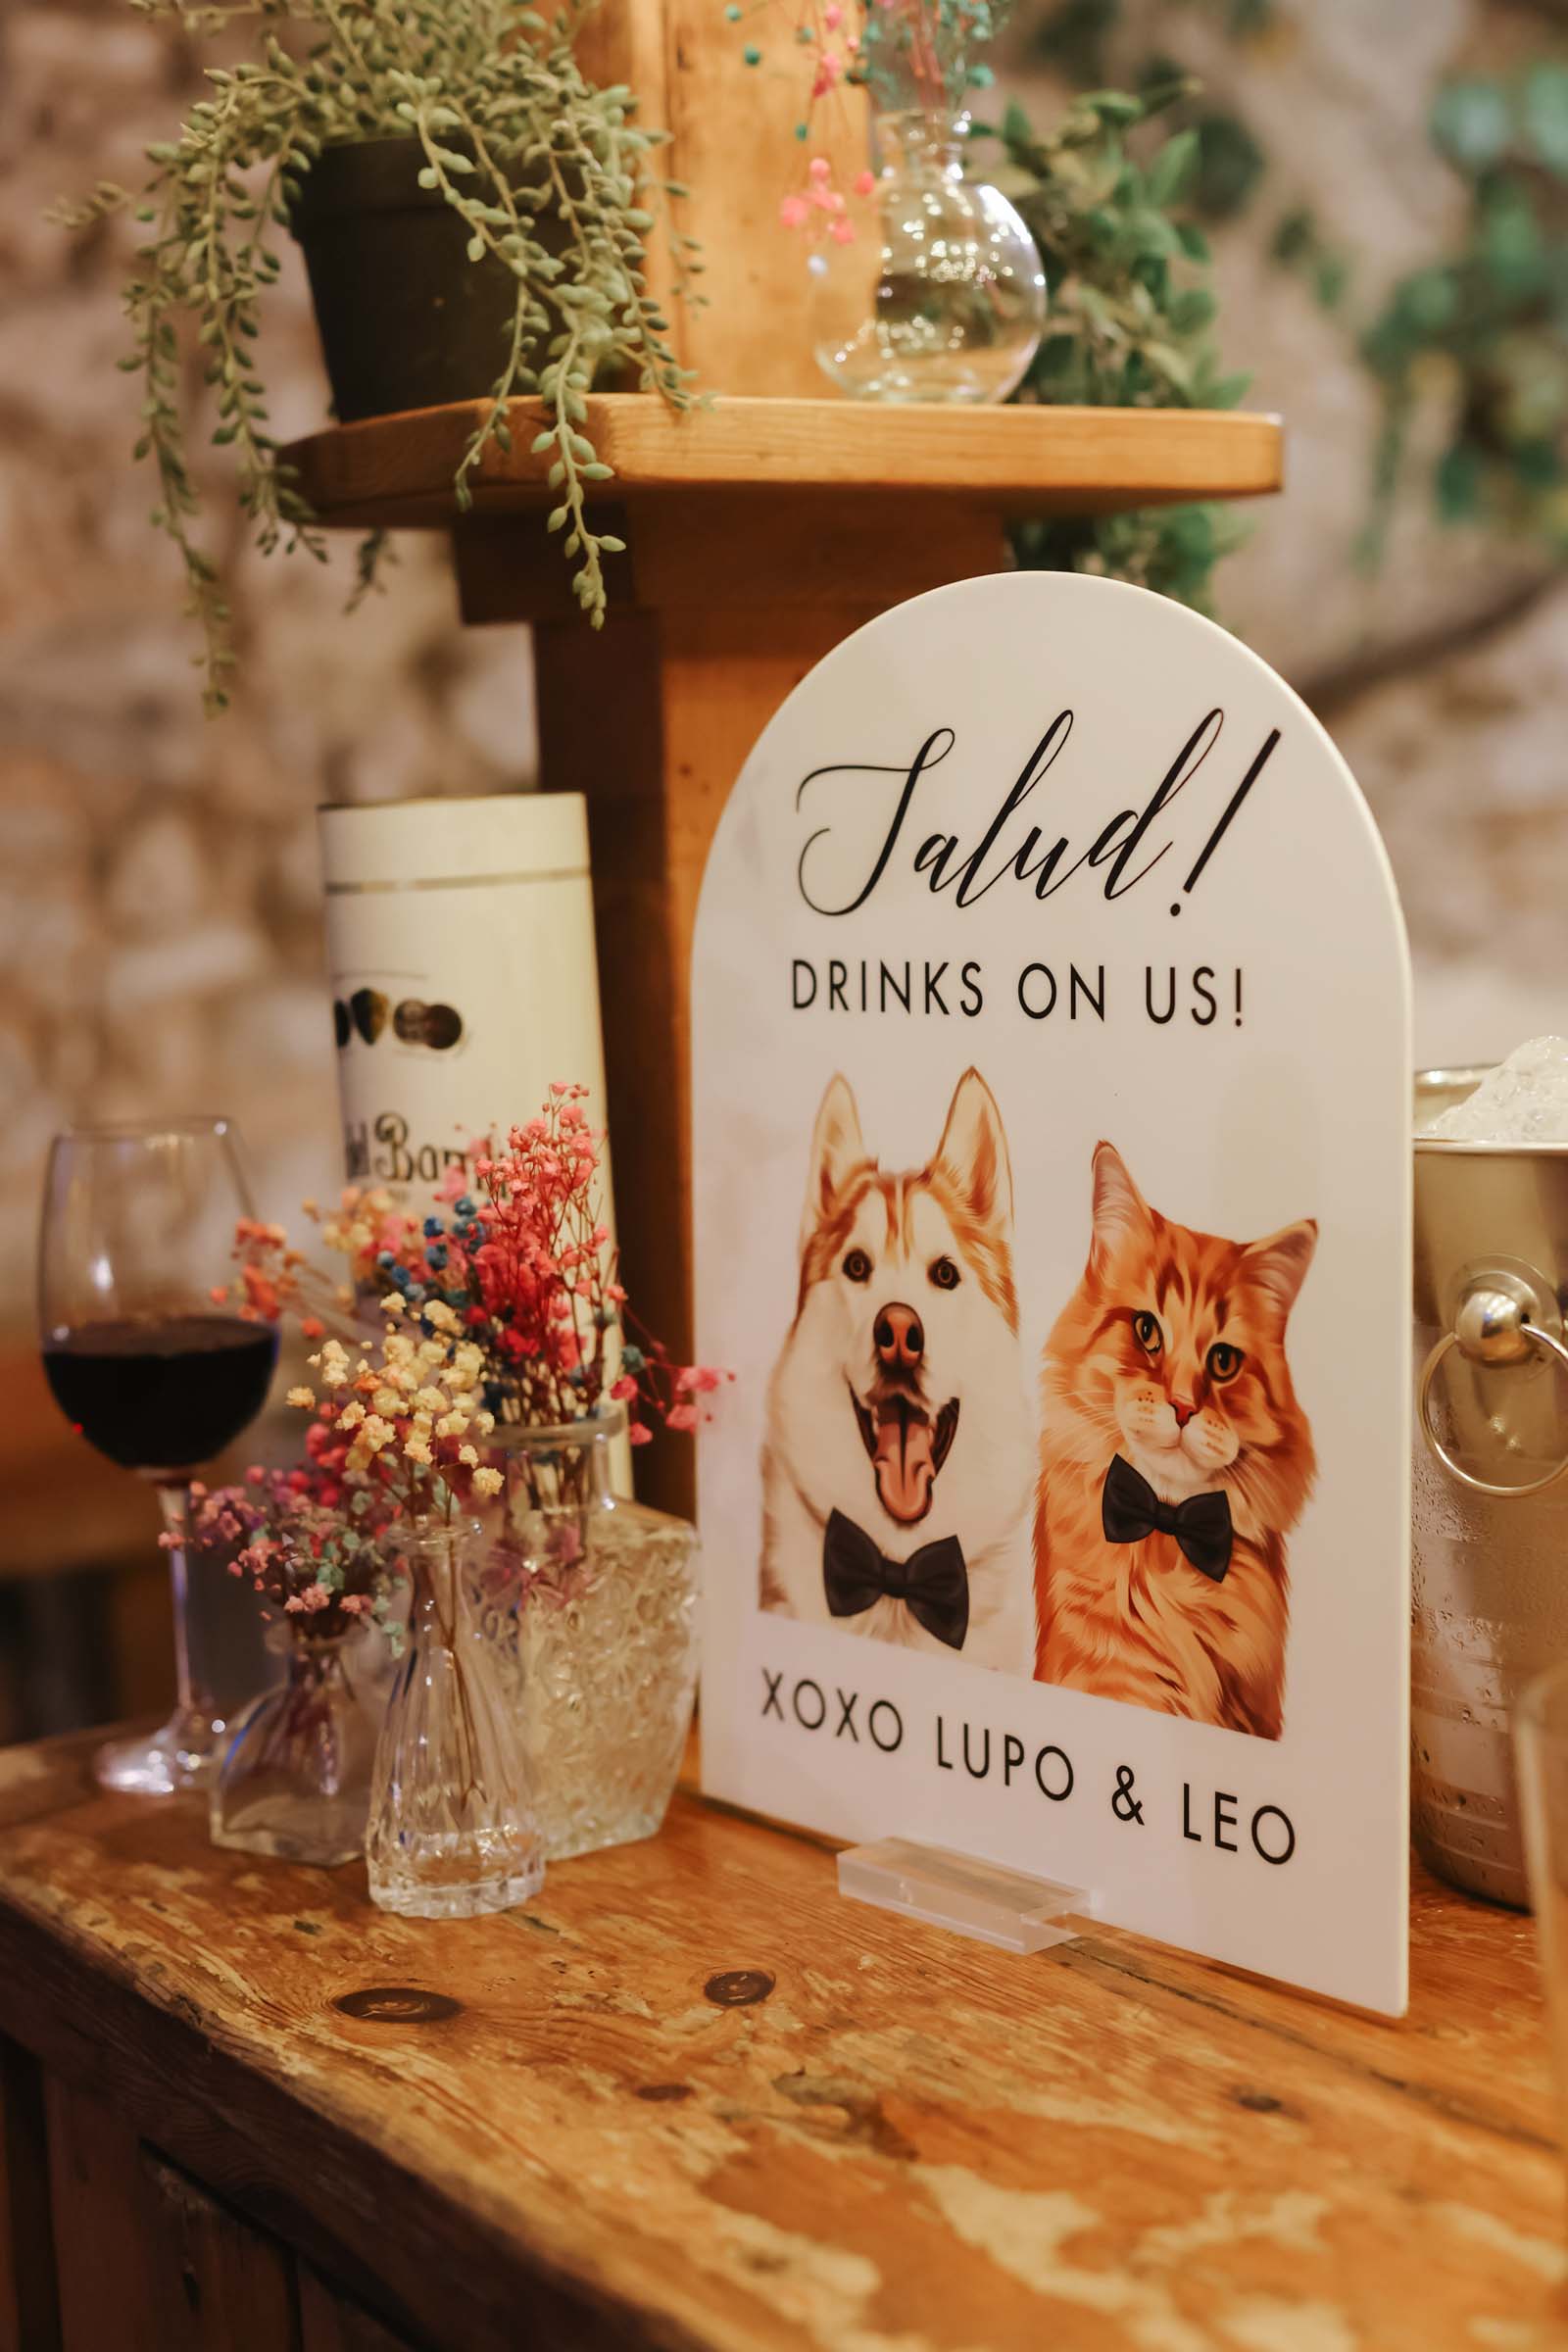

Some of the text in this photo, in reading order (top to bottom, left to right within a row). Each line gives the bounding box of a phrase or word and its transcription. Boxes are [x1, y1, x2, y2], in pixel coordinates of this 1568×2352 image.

[795, 708, 1282, 917] Salud!
[792, 958, 1244, 1027] DRINKS ON US!
[761, 1668, 1297, 1867] XOXO LUPO & LEO
